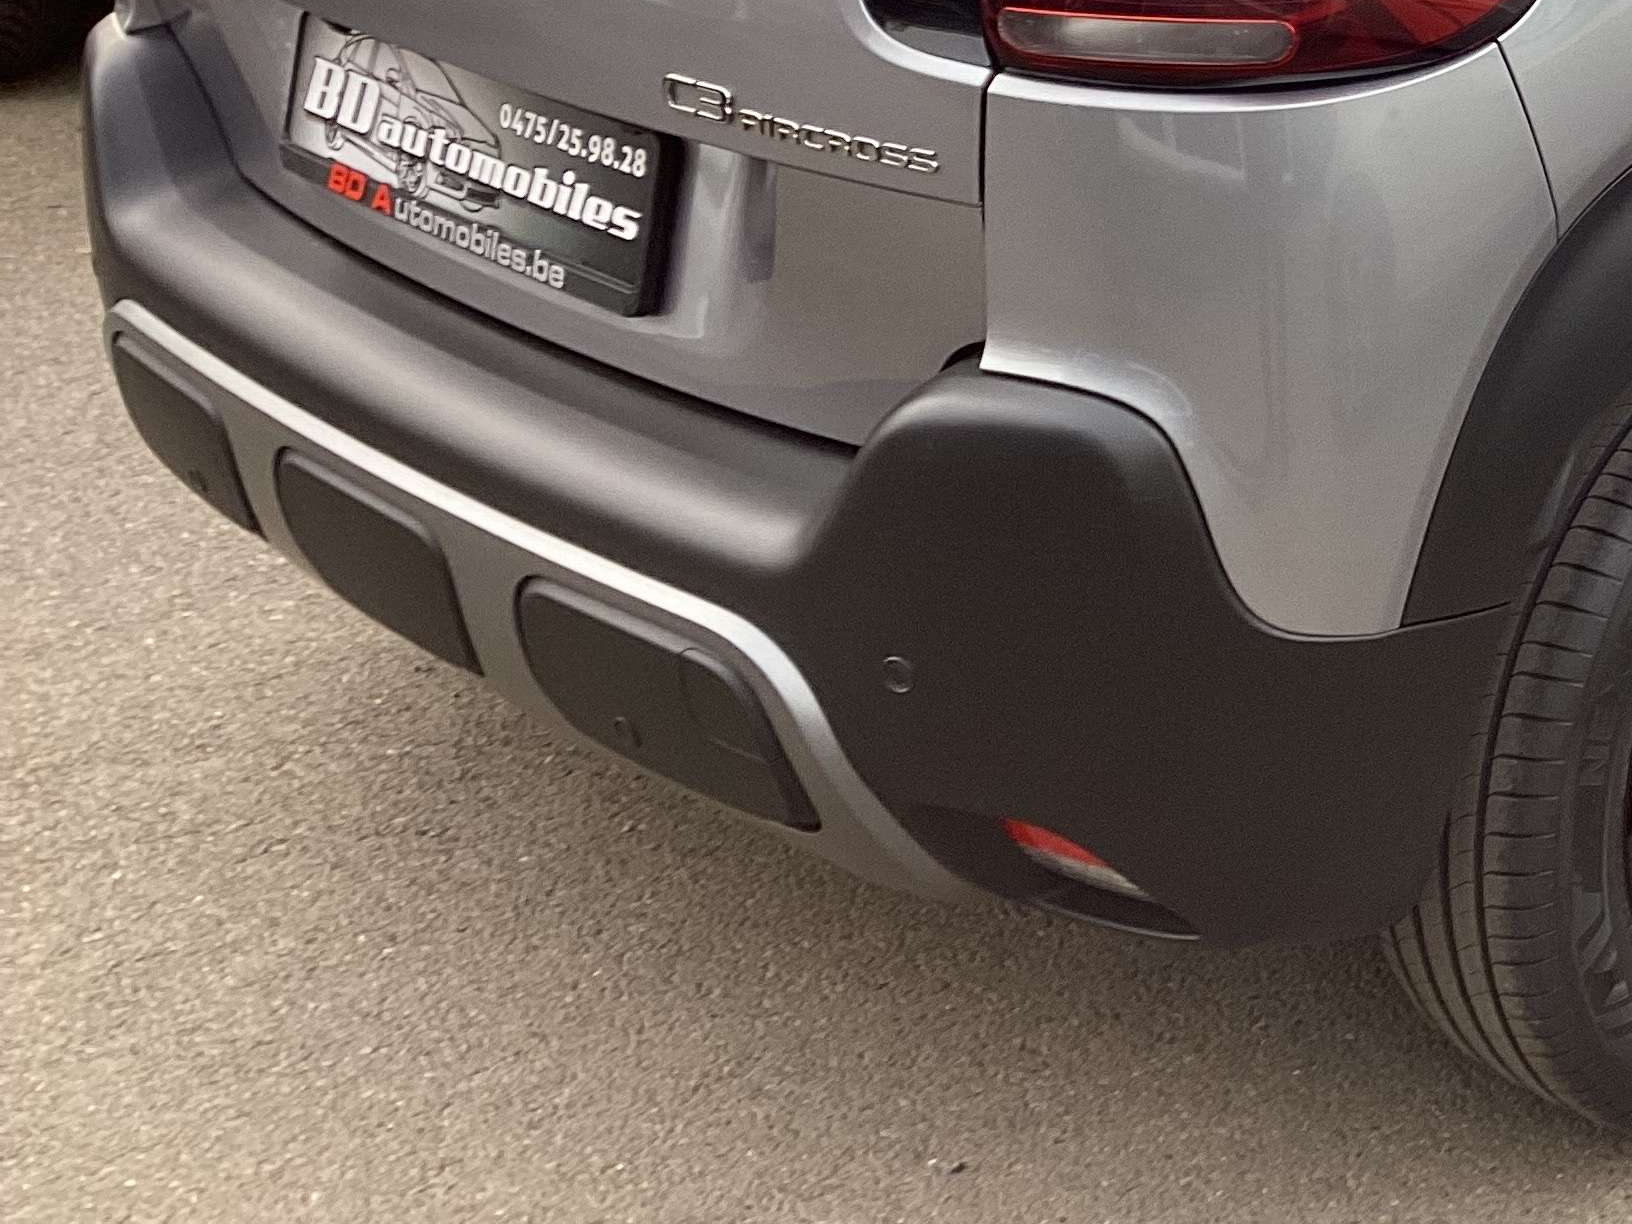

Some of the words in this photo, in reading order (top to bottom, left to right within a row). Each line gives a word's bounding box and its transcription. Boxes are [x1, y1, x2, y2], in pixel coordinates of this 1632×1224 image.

[499, 102, 647, 178] 0475/25.98.28
[664, 72, 734, 123] C3
[738, 108, 940, 173] AIRCROSS
